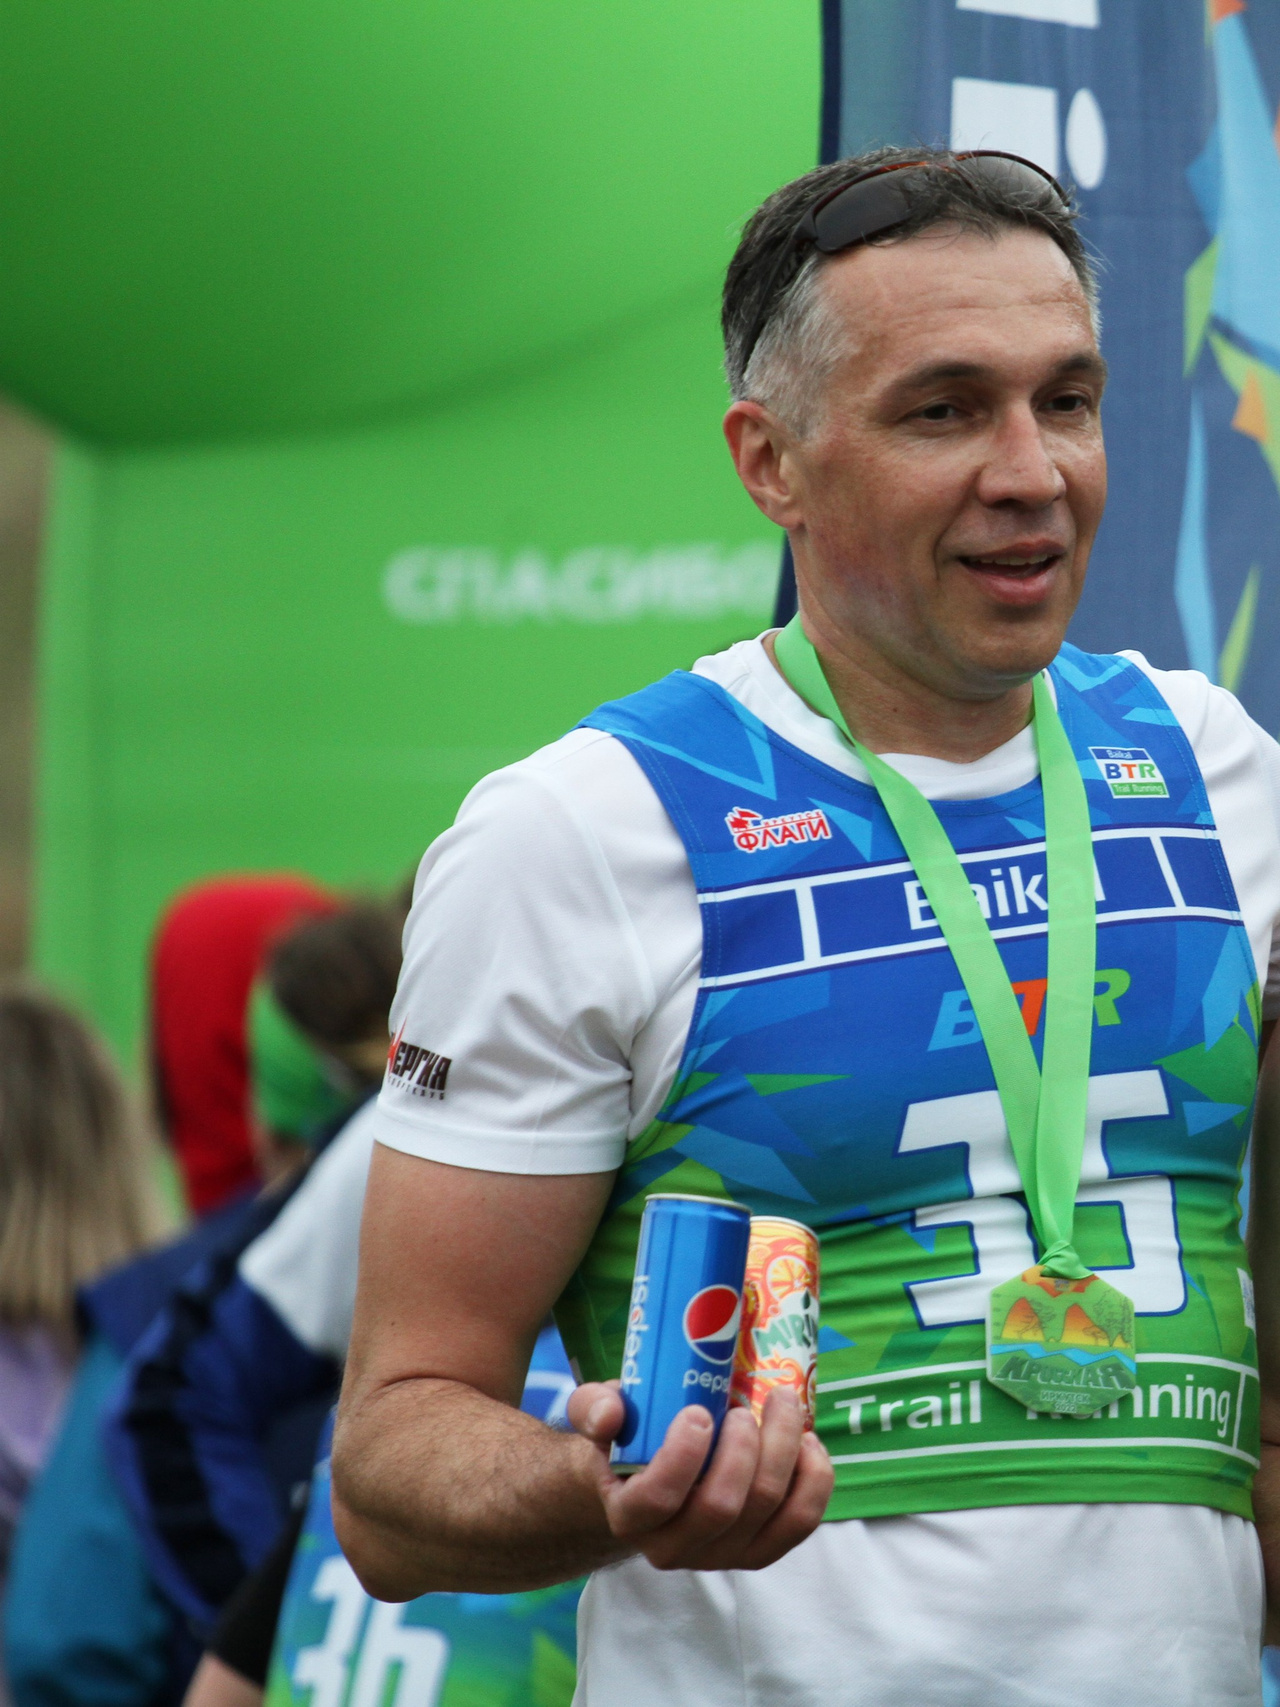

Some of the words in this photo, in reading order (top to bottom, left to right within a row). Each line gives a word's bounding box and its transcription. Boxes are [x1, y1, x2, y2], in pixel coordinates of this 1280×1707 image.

[1105, 763, 1157, 779] BTR
[737, 818, 830, 851] ФЛАГИ
[903, 854, 1106, 931] Baikl
[927, 968, 1131, 1052] BTR
[621, 1275, 650, 1385] pepsi
[682, 1368, 731, 1394] peps
[835, 1380, 982, 1435] Trail
